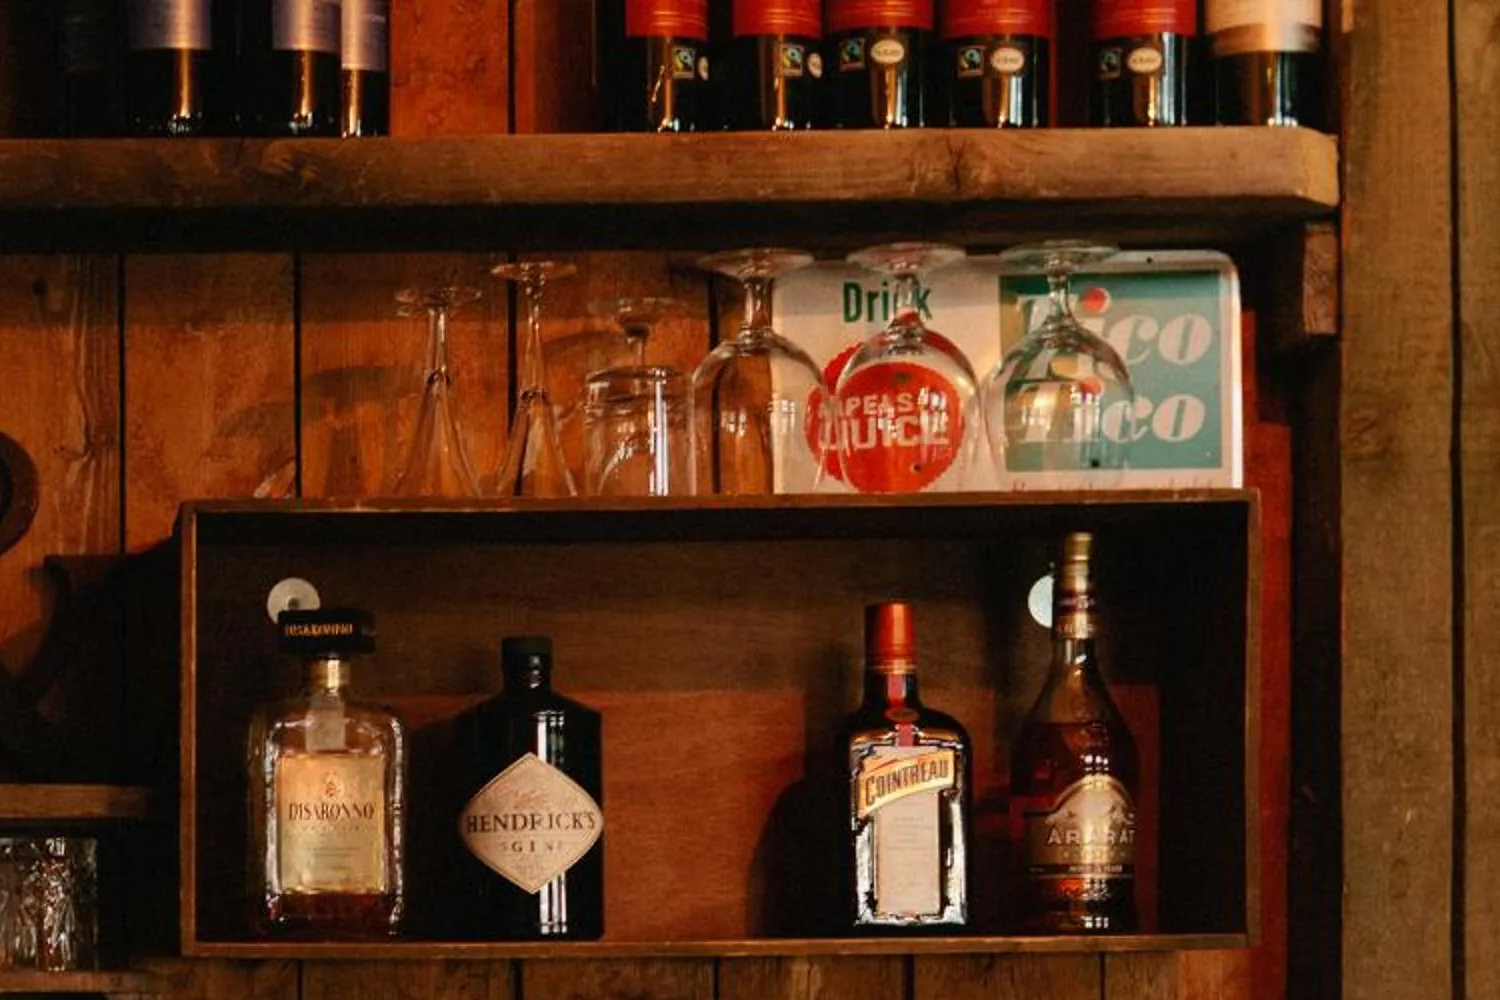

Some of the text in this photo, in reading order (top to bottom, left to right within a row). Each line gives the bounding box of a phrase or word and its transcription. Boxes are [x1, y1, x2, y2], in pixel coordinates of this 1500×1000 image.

[864, 758, 949, 807] COINTREAU
[289, 803, 375, 821] DISARONNO
[466, 811, 596, 834] HENDRICK'S
